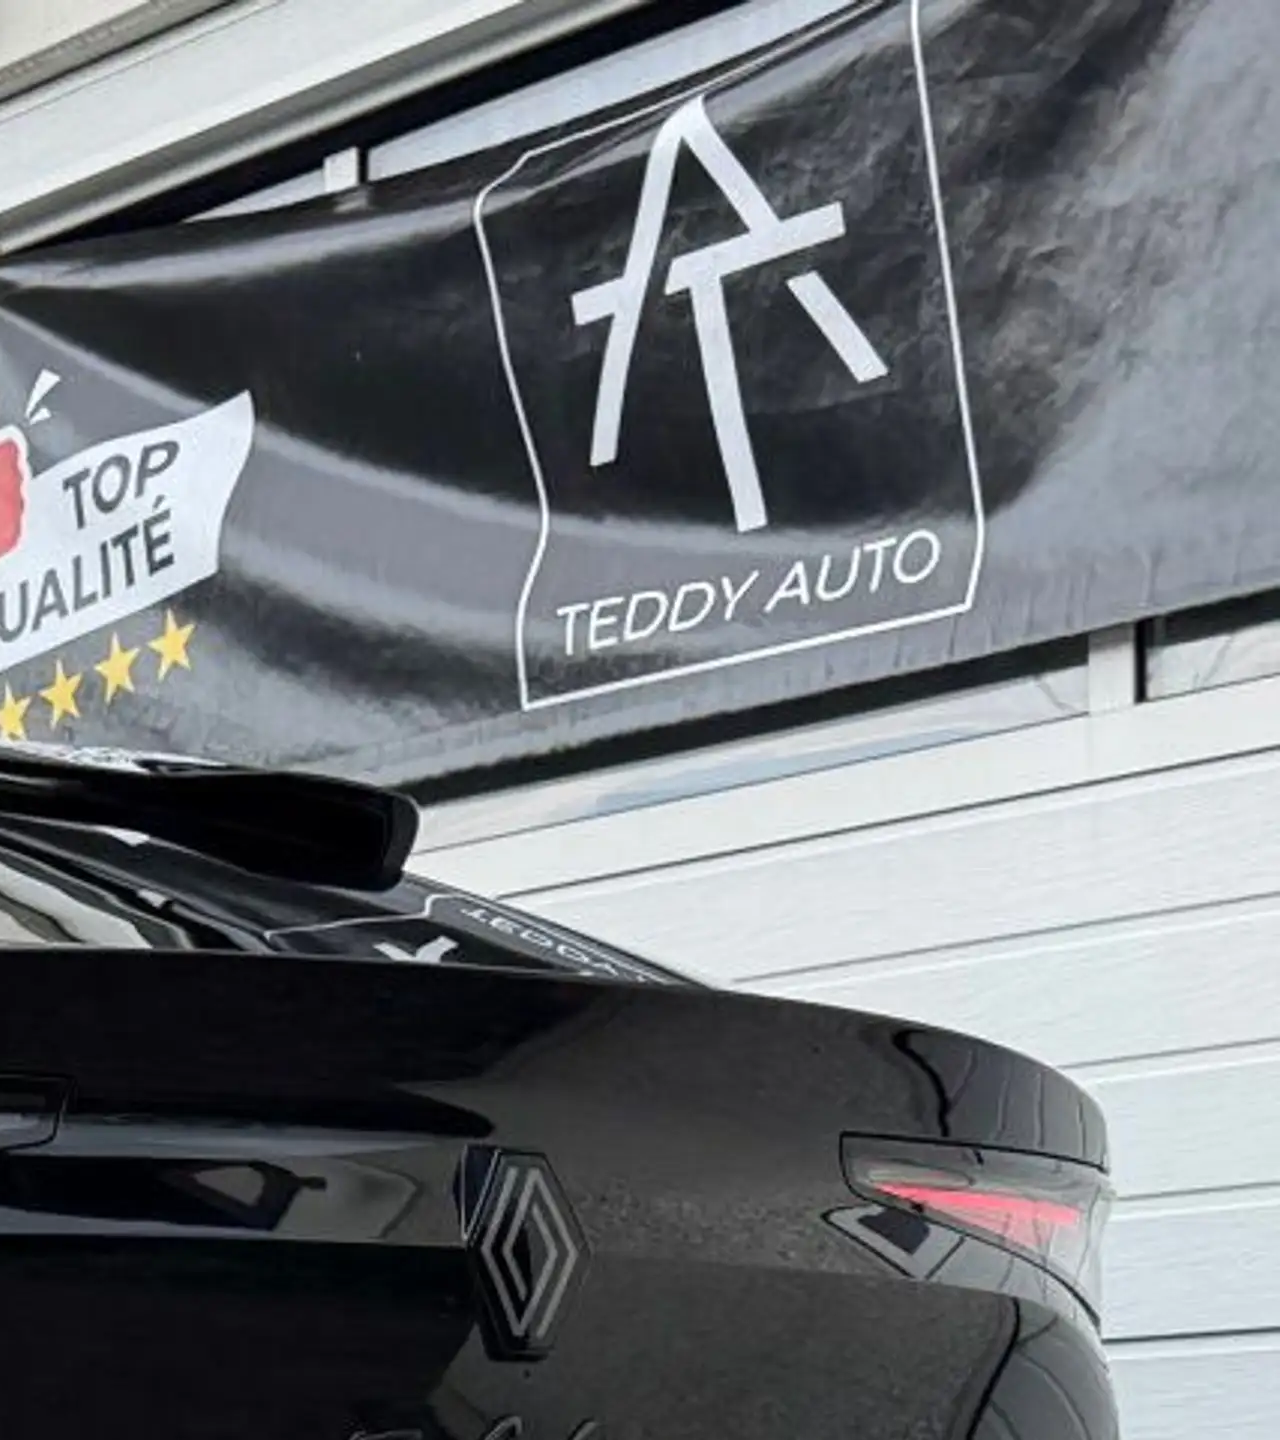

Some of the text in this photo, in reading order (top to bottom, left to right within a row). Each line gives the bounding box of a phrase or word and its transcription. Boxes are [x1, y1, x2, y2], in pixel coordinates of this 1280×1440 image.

[62, 440, 180, 529] TOP
[557, 530, 941, 656] TEDDY AUTO
